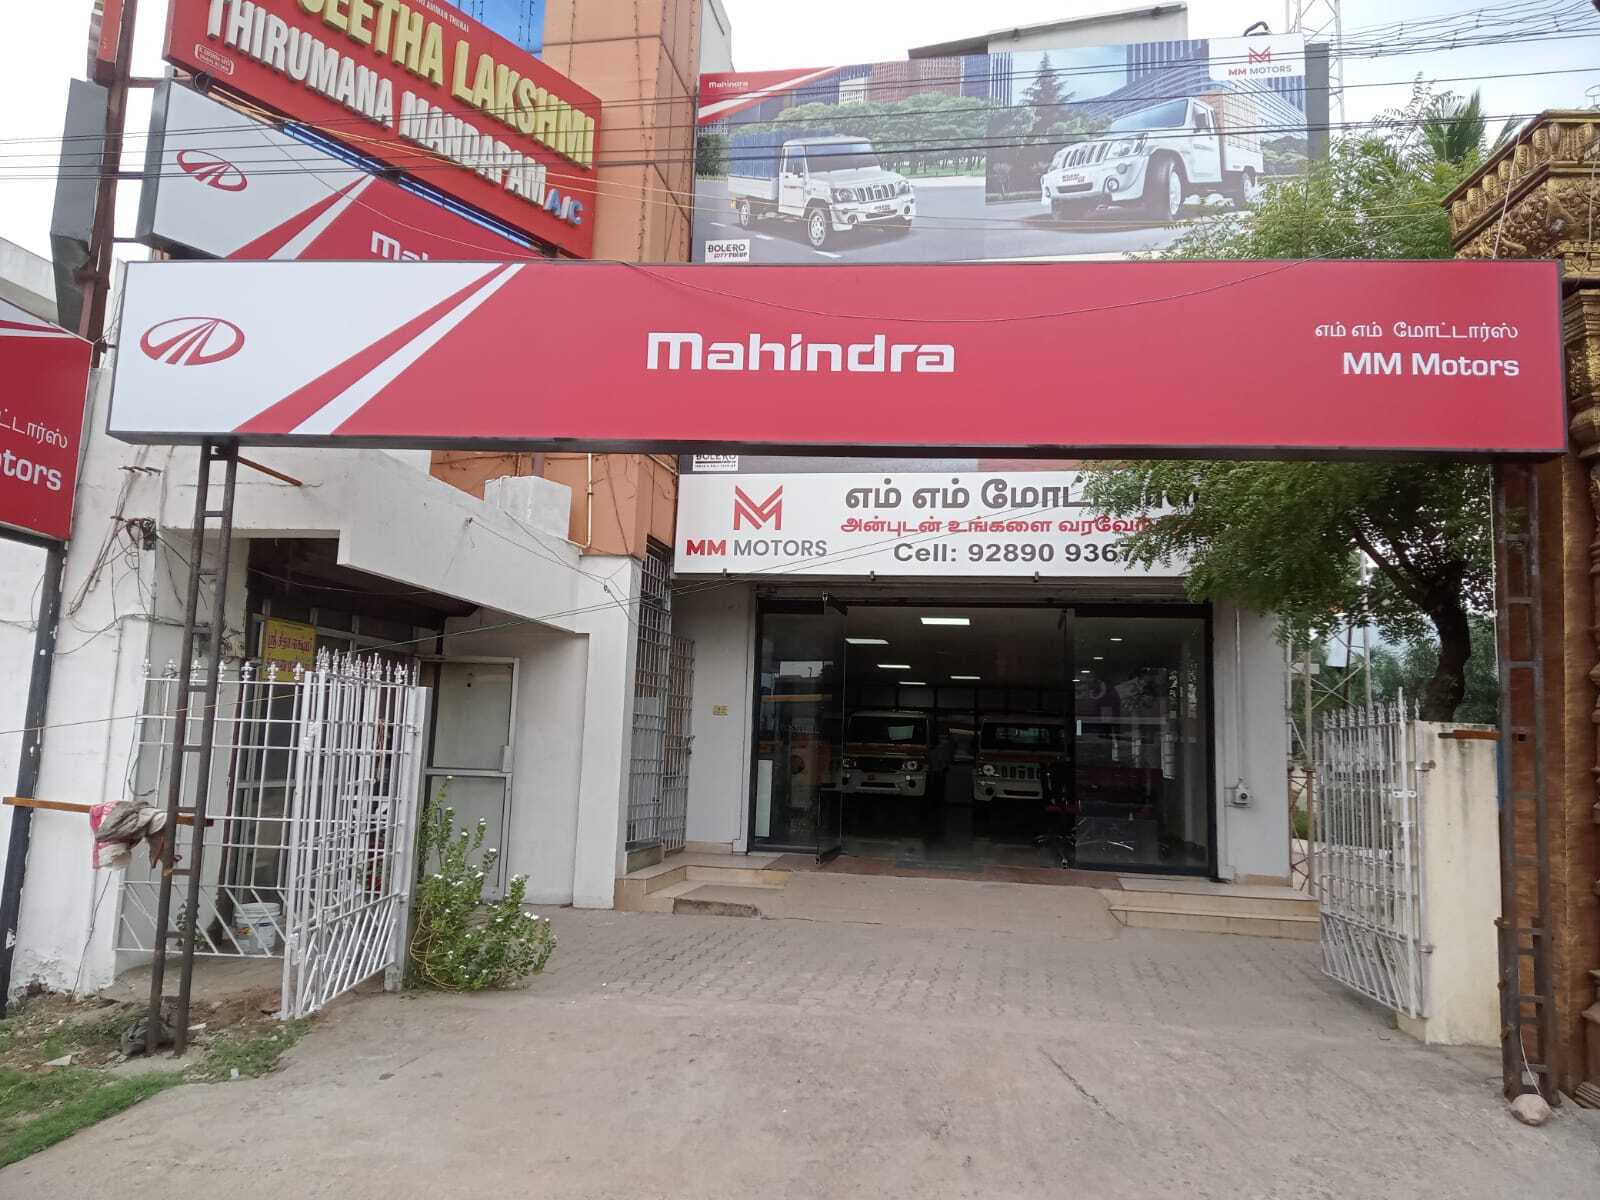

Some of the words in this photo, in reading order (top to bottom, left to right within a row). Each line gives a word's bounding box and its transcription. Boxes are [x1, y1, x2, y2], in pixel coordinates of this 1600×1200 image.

[1228, 68, 1247, 76] MM
[1249, 65, 1292, 74] MOTORS
[207, 0, 393, 128] THIRUMANA
[399, 90, 546, 206] MANDAPAM
[452, 40, 594, 169] LAKSHMI
[708, 243, 746, 252] BOLERO
[1315, 321, 1346, 337] எம்
[1352, 321, 1383, 337] எம்
[1393, 321, 1518, 343] மோட்டார்ஸ்
[1343, 352, 1402, 376] MM
[1412, 352, 1520, 377] Motors
[0, 448, 62, 491] tors
[846, 478, 902, 509] எம்
[912, 478, 970, 509] எம்
[841, 516, 943, 536] அன்புடன்
[948, 516, 1052, 533] உங்களை
[686, 539, 727, 556] MM
[734, 539, 828, 557] MOTORS
[894, 543, 957, 562] Cell:
[968, 543, 1054, 562] 92890
[1065, 543, 1138, 562] 9367
